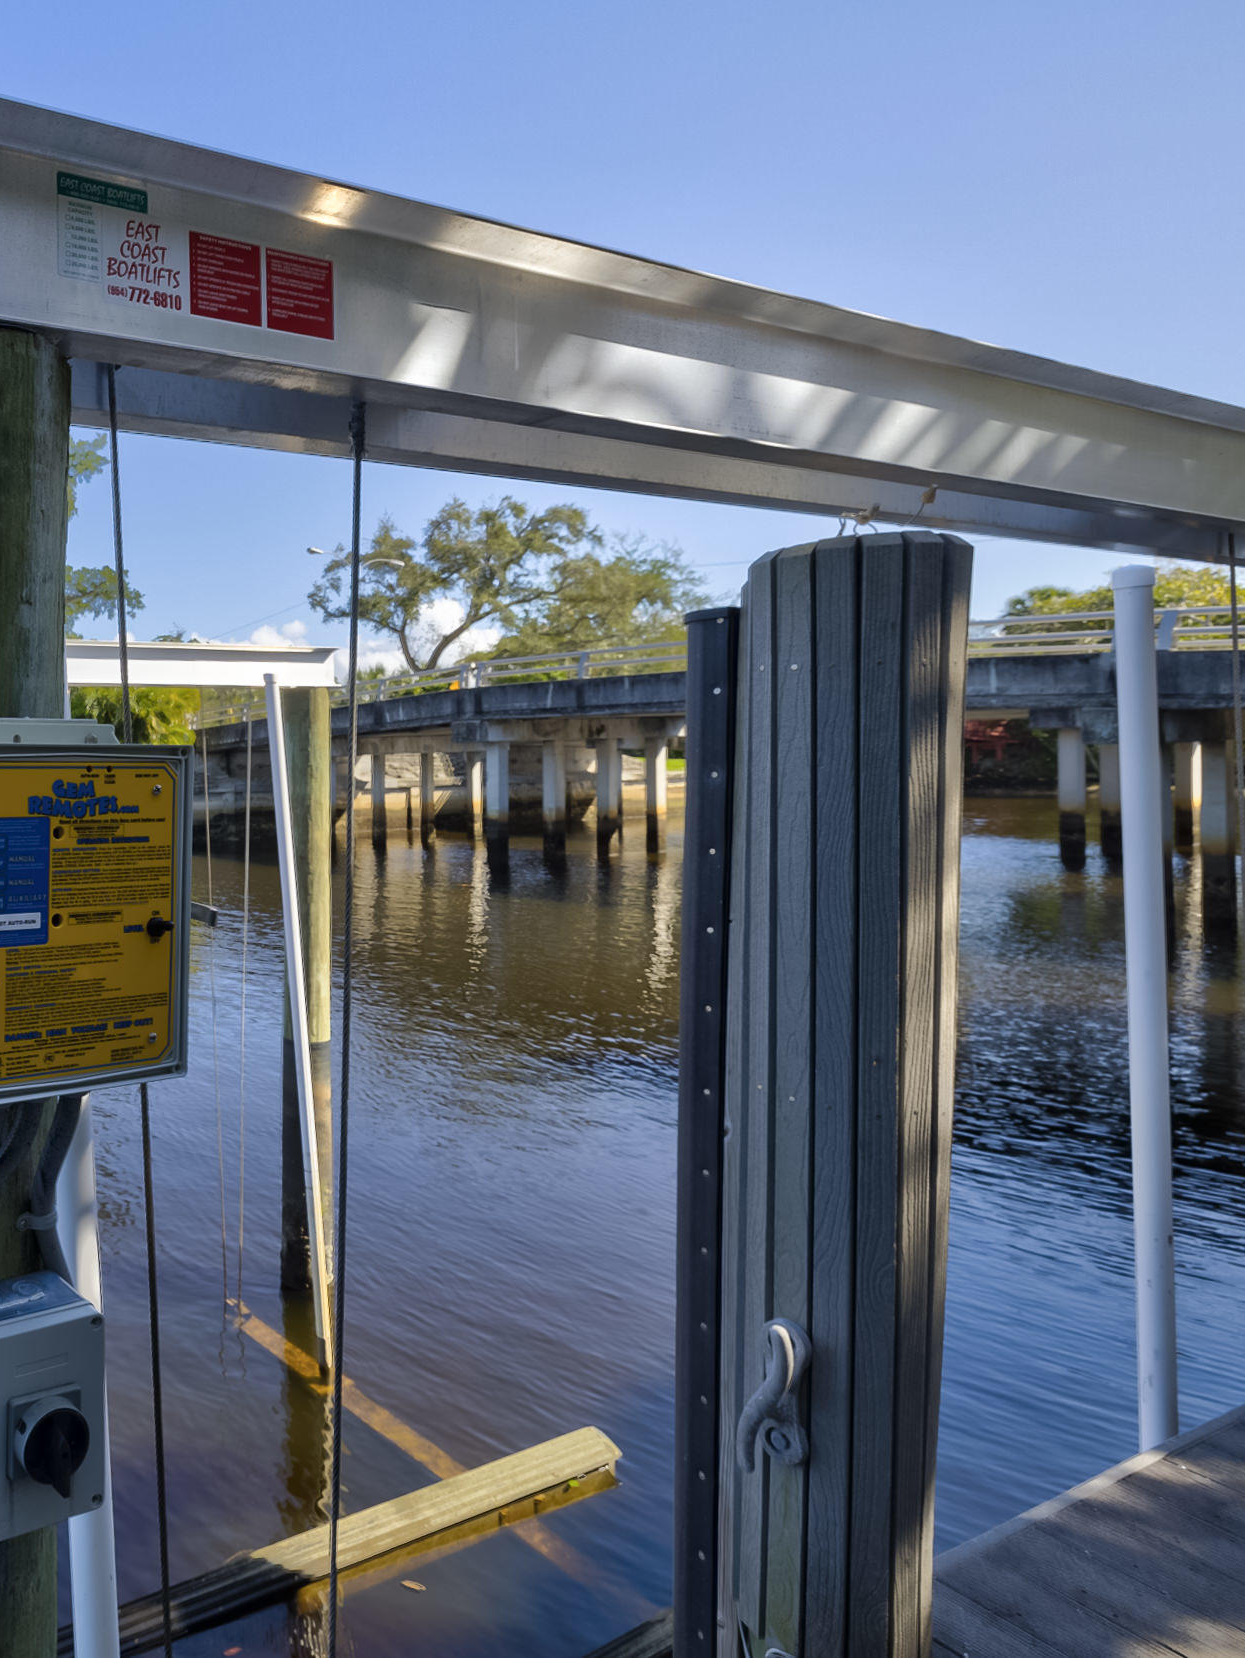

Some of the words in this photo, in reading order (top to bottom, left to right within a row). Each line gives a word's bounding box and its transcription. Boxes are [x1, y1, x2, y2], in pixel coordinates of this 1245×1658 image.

[60, 176, 79, 190] EAST
[80, 182, 105, 197] COAST
[107, 187, 146, 206] BOATLIFTS
[126, 220, 161, 243] EAST
[120, 240, 167, 265] COAST
[107, 257, 180, 289] BOATLIFTS
[129, 286, 181, 311] 772-6810
[52, 779, 95, 799] GEM
